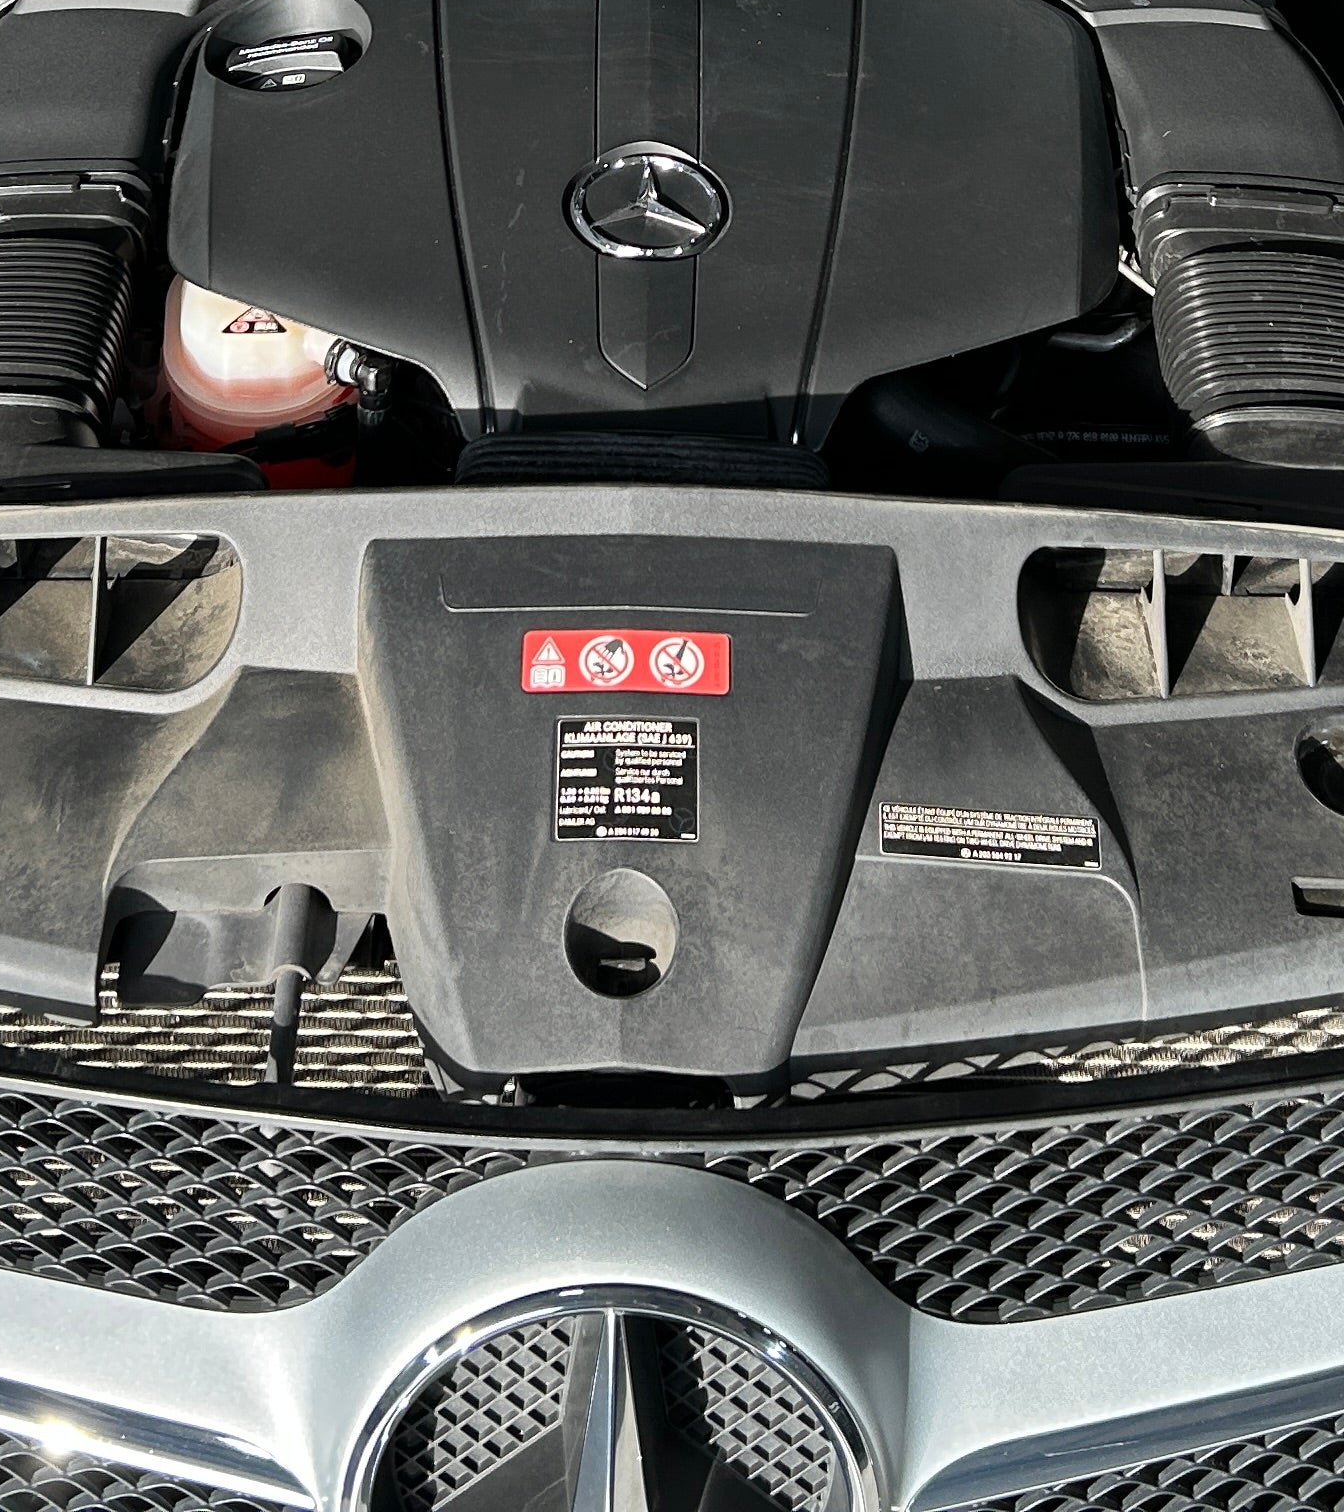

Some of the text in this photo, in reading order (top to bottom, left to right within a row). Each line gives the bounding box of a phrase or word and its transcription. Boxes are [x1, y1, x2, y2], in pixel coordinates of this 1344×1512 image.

[584, 722, 672, 732] AIR CONDITIONER
[564, 733, 635, 743] KLIMAANLAGE
[615, 788, 660, 803] R134a
